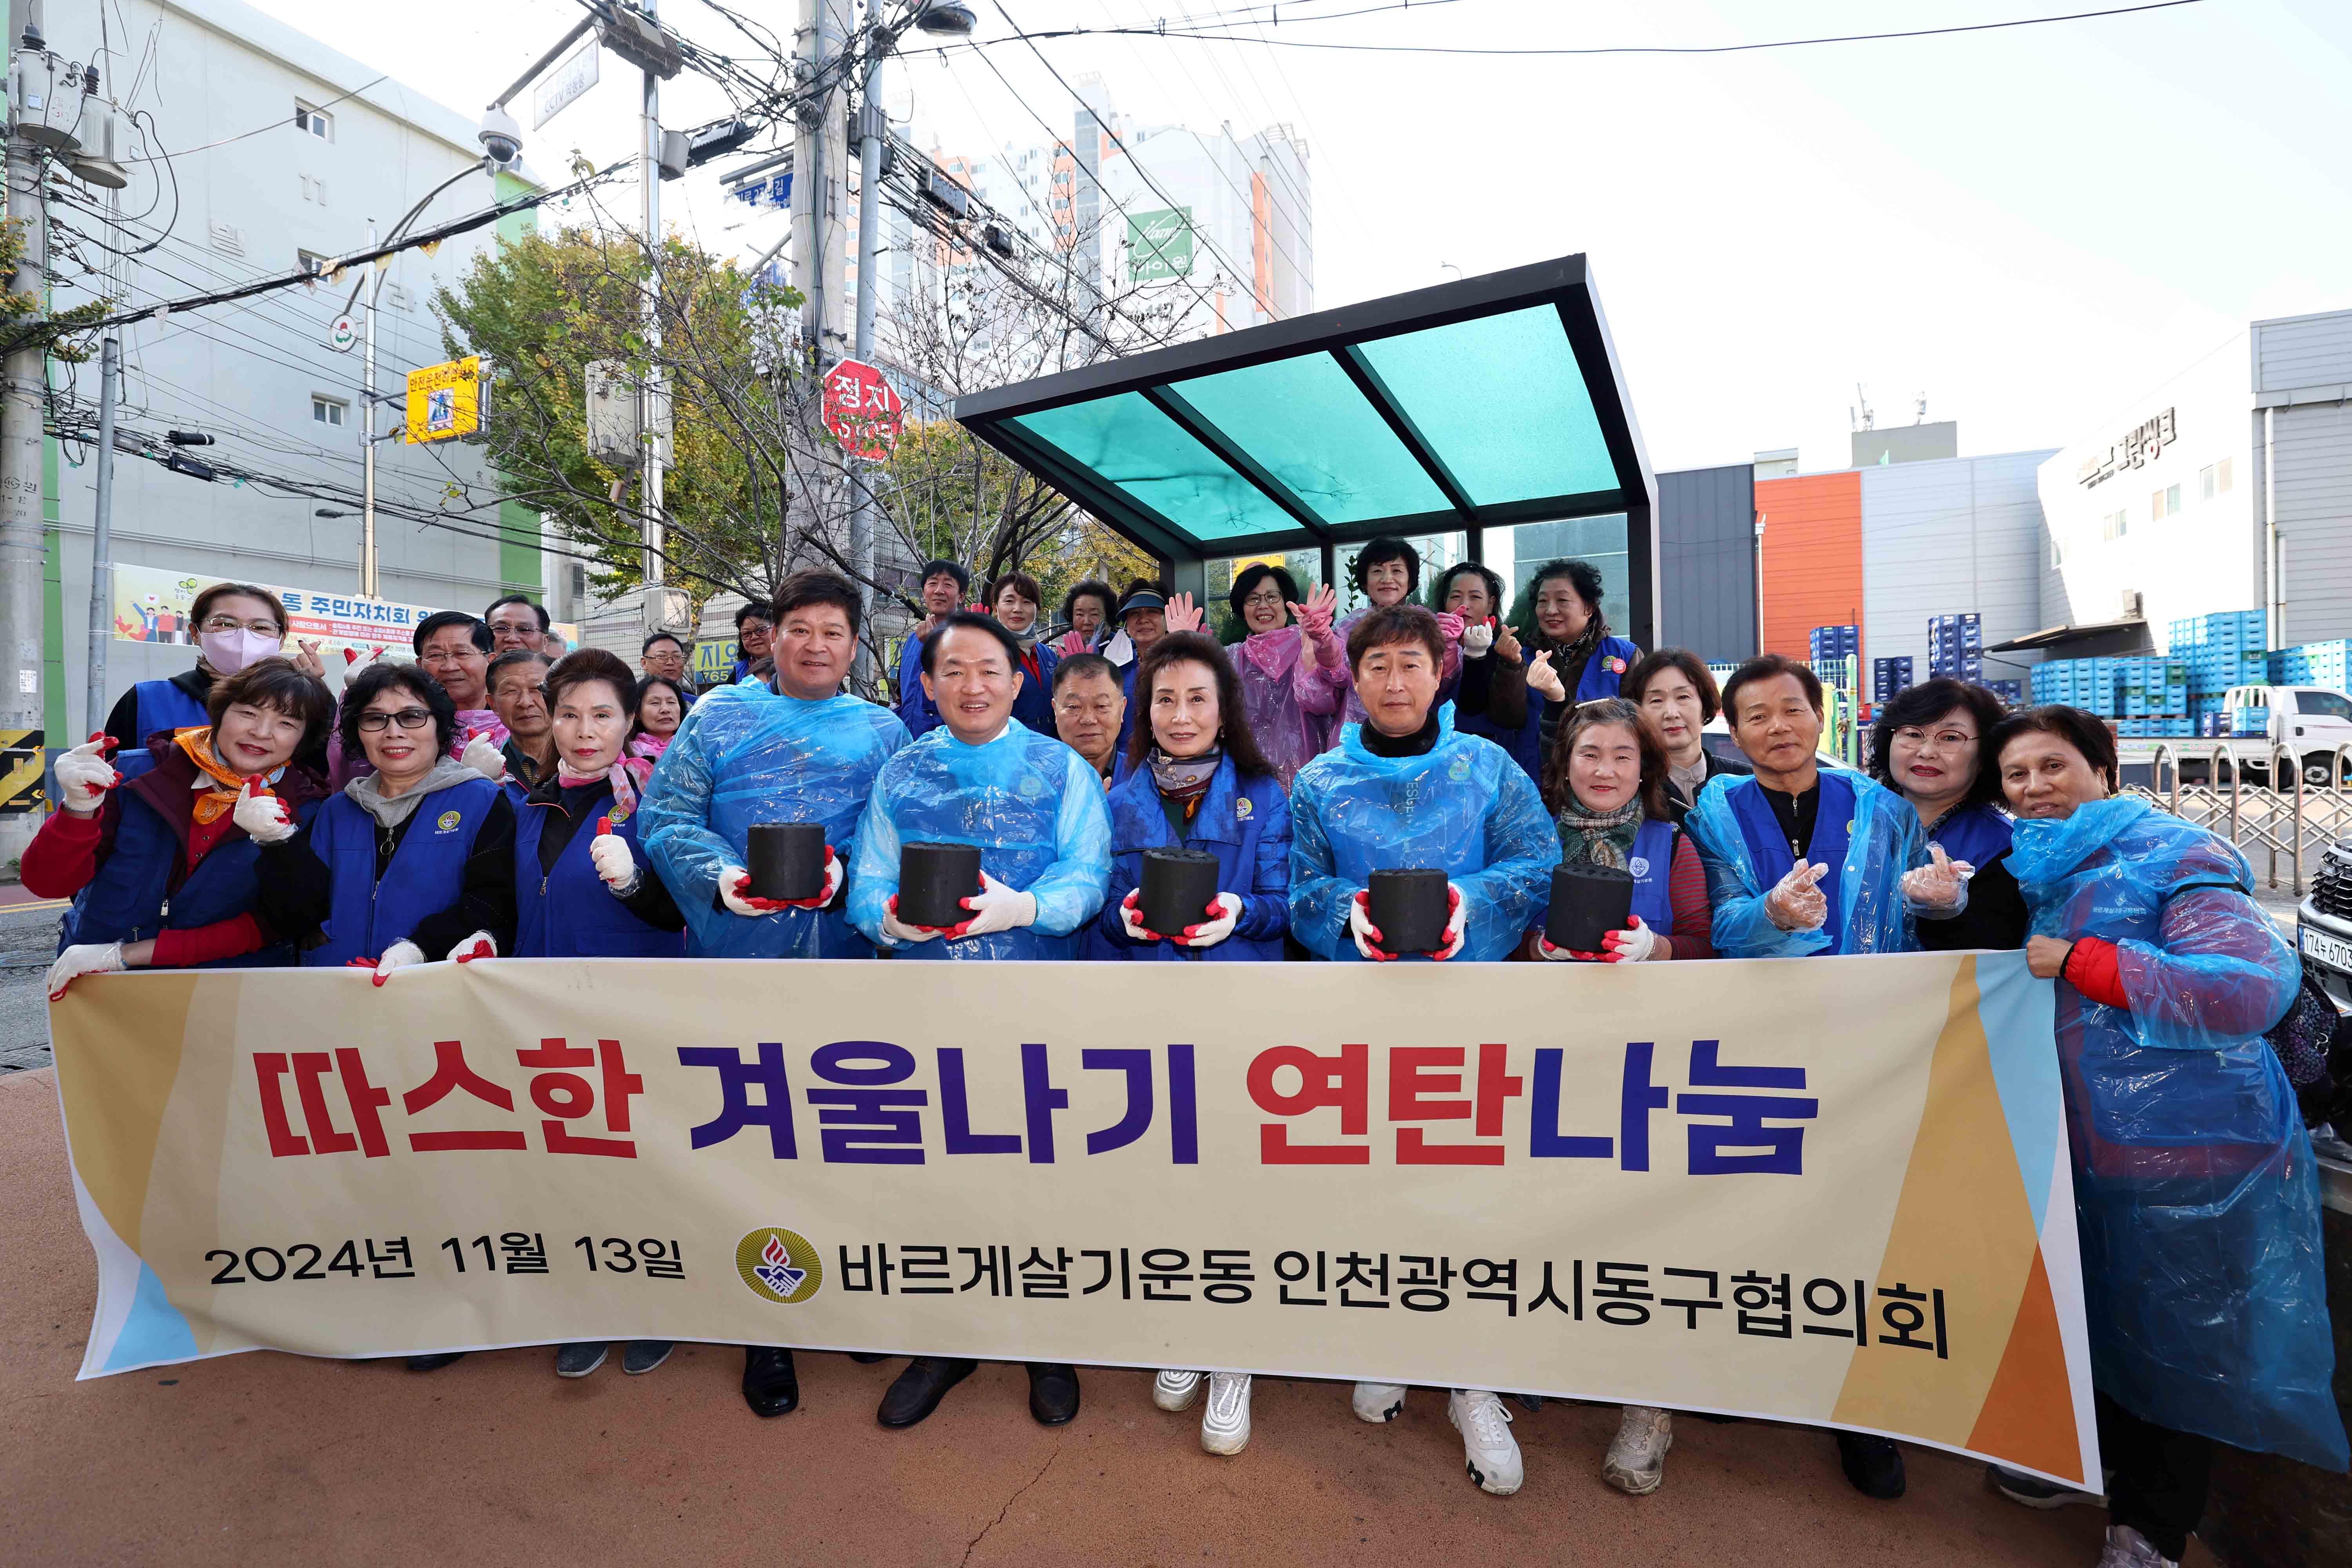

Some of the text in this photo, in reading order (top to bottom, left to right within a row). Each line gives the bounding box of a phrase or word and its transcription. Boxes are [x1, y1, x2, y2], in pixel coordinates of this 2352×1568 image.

[545, 88, 564, 113] CCTV
[1133, 255, 1189, 276] 아이원
[834, 374, 890, 412] 정지
[281, 592, 302, 612] 동
[310, 596, 410, 624] 주민자치회
[2305, 933, 2352, 969] 174누 6703
[254, 1038, 1819, 1175] 따스한 겨울나기 연탄나눔
[205, 1232, 1948, 1360] 2024년 11월 13일 바르게살기운동 인천광역시동구협의회
